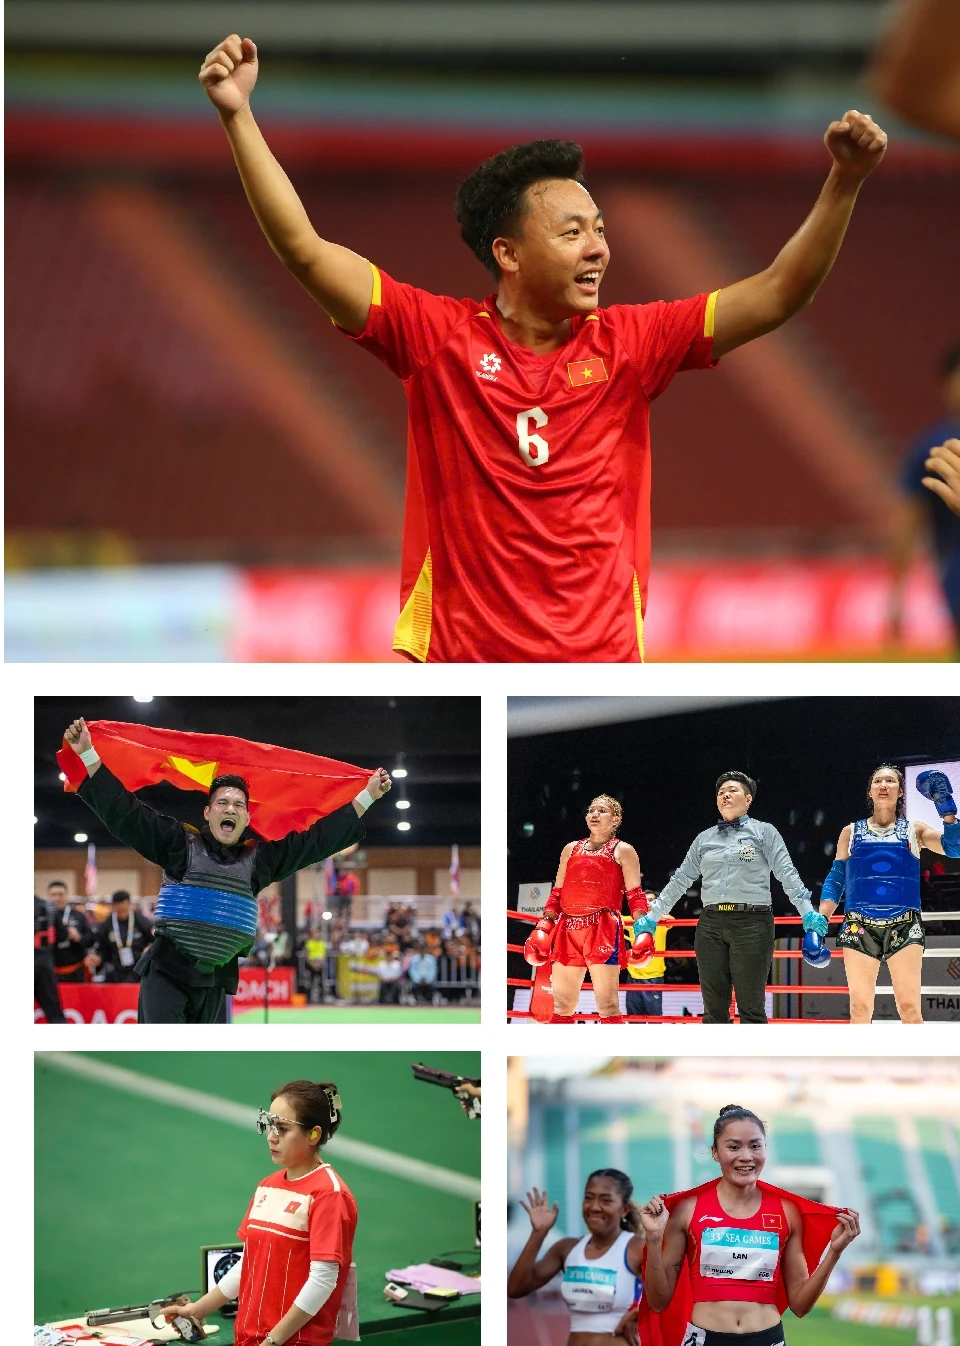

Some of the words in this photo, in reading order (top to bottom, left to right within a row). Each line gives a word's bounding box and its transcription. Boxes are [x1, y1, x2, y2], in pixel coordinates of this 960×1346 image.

[516, 406, 549, 467] 6
[725, 1232, 740, 1243] SEA
[743, 1235, 771, 1245] GAMES
[732, 1252, 748, 1260] LAN
